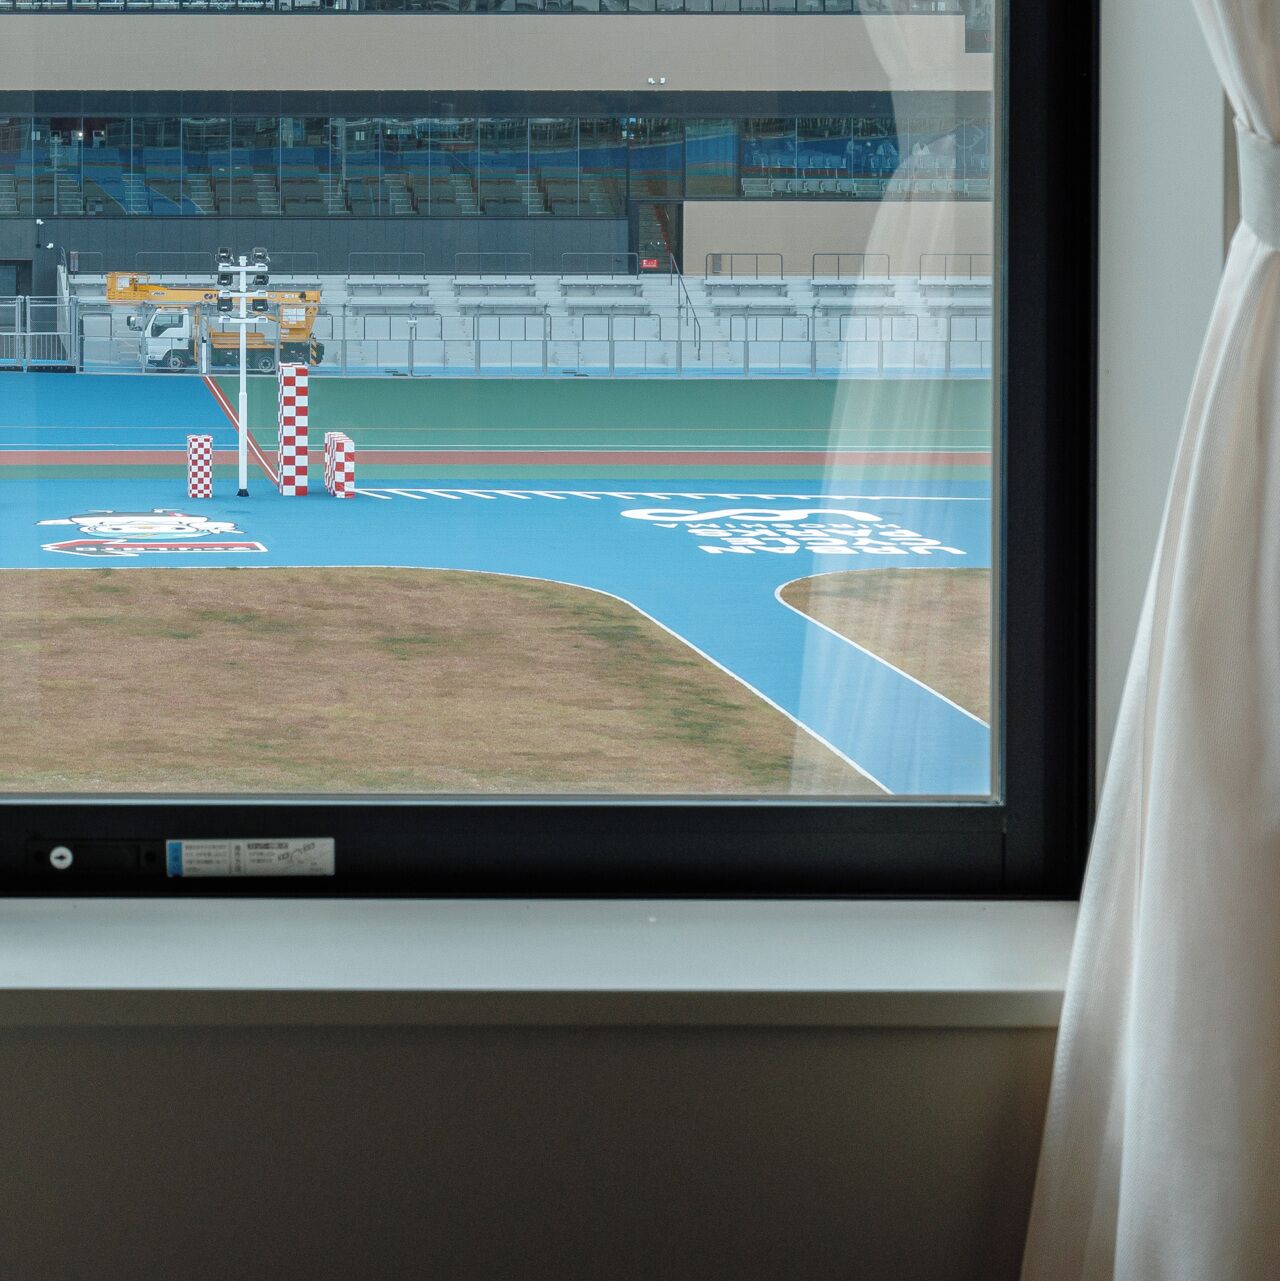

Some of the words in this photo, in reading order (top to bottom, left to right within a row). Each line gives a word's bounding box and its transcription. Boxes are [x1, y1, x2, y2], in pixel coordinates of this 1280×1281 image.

[687, 528, 923, 537] PARKS
[720, 537, 942, 546] CYCLE
[697, 545, 968, 555] URBAN
